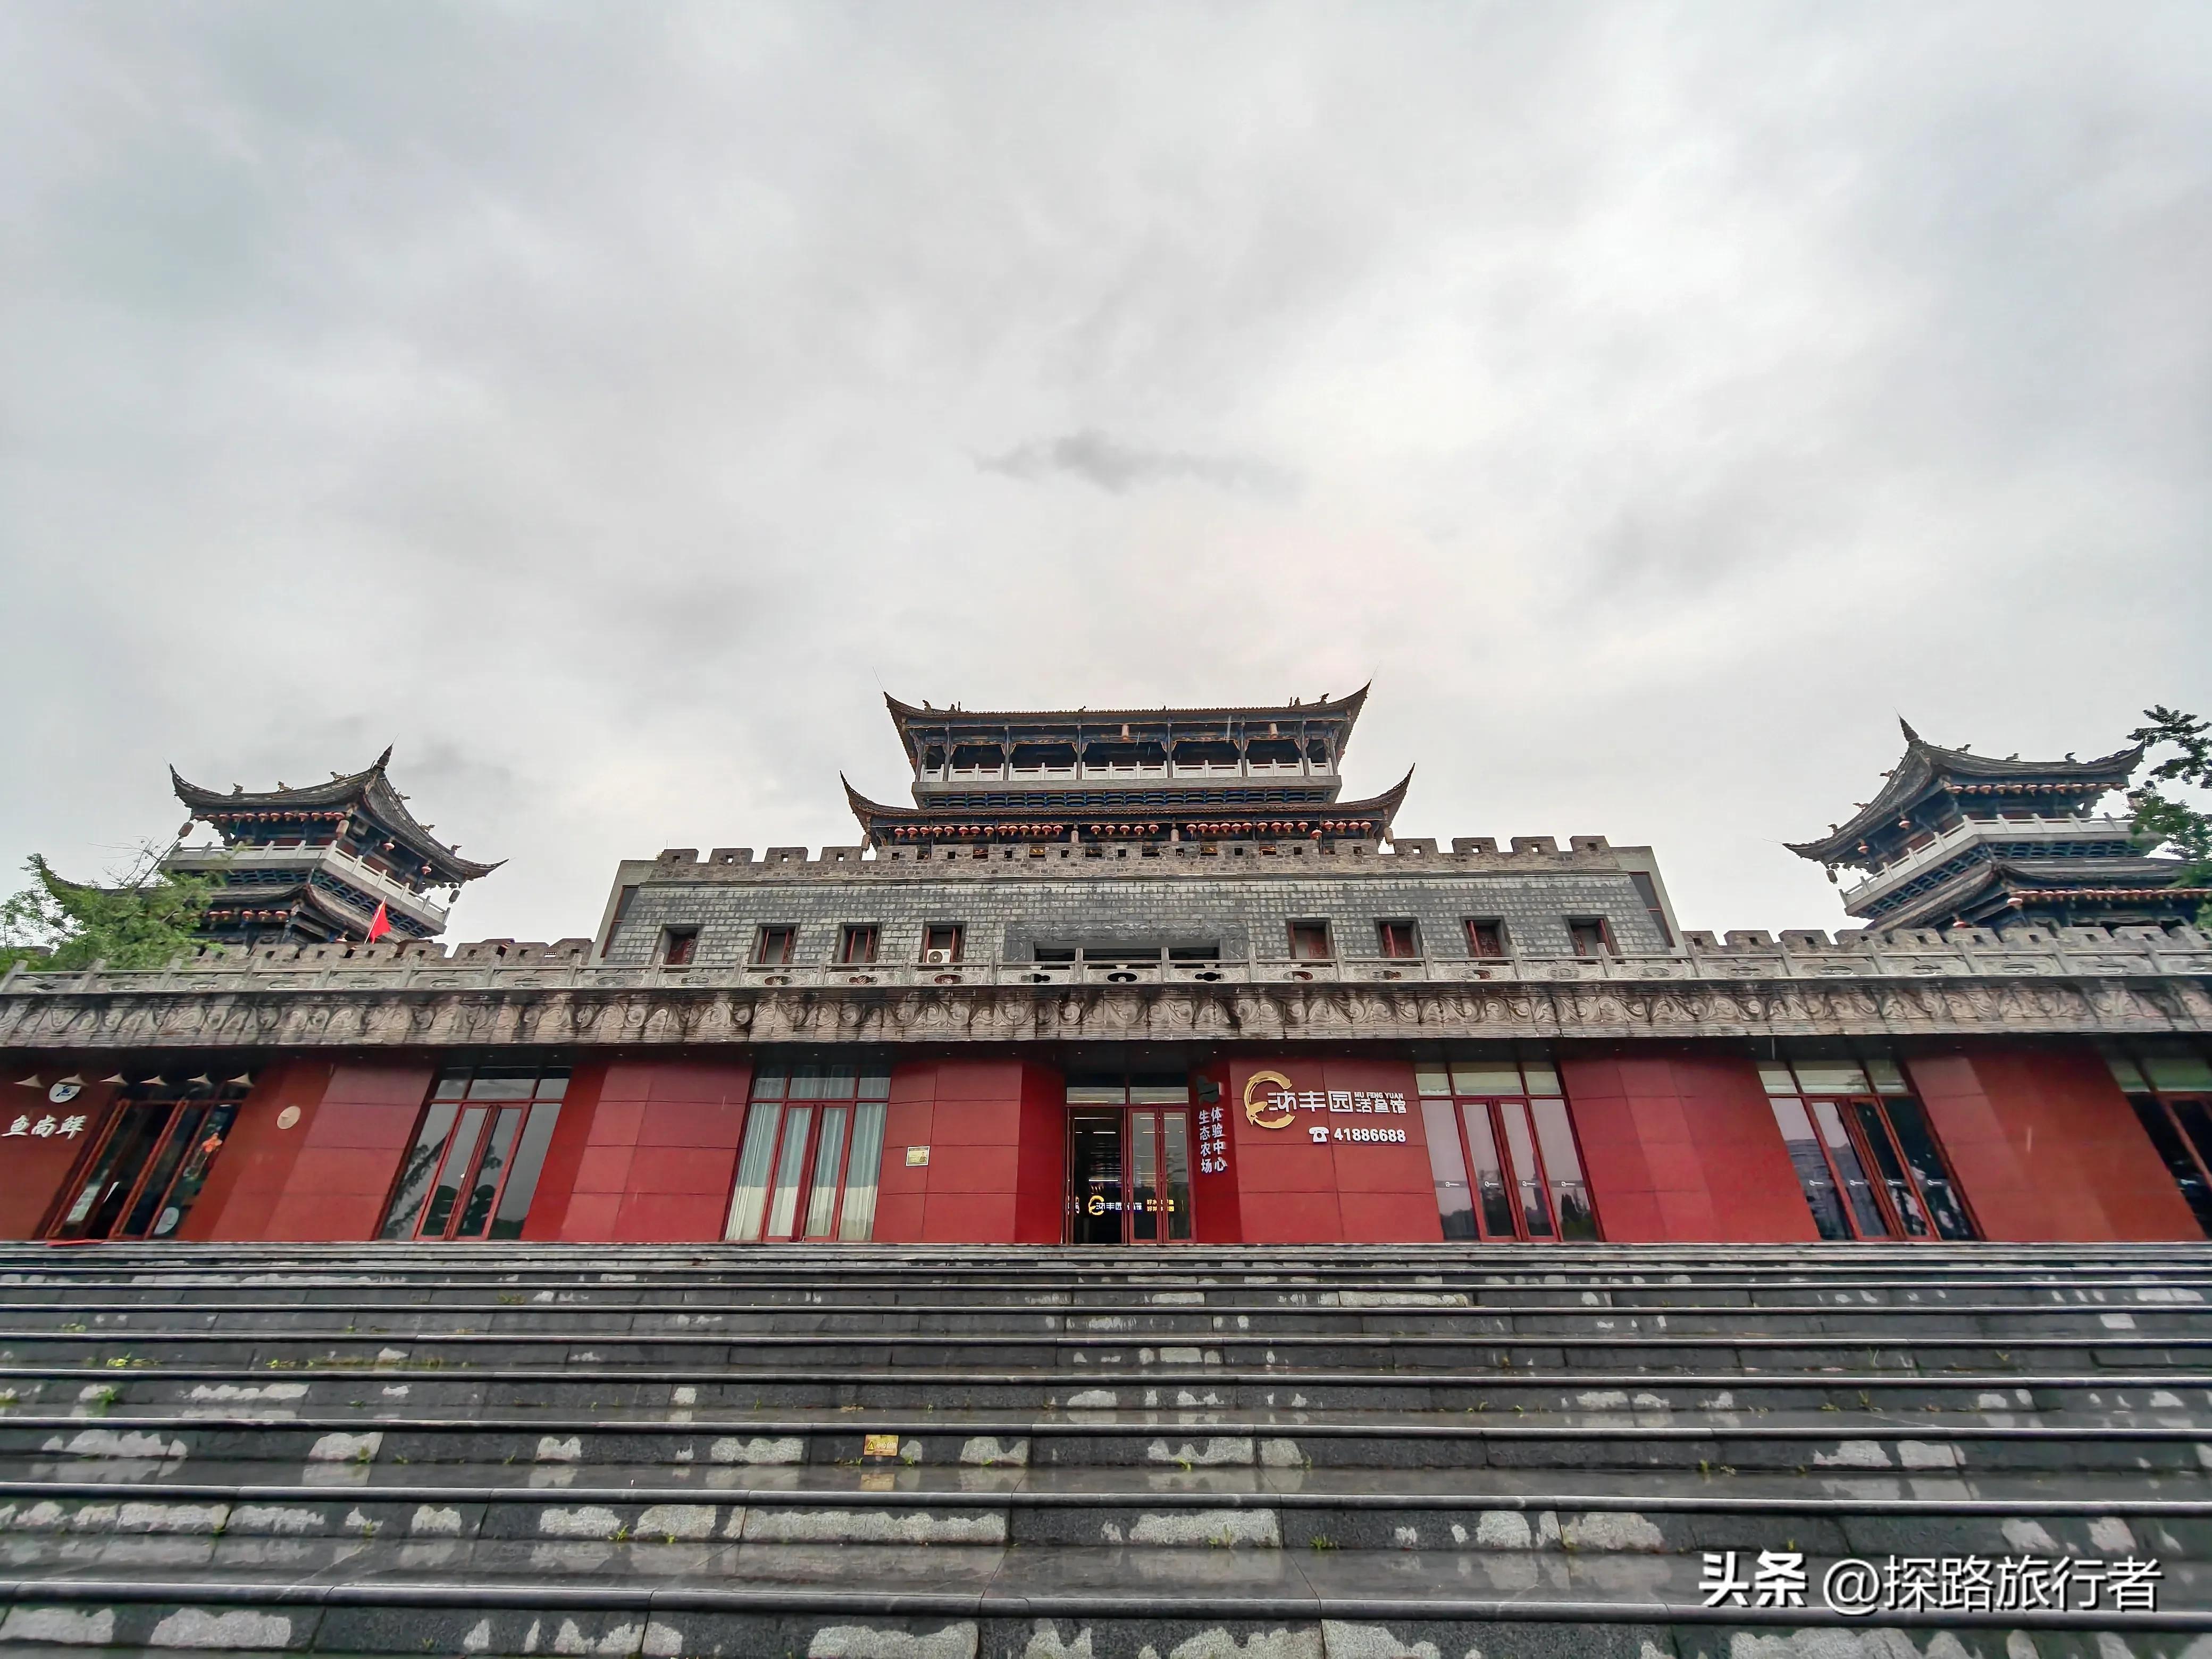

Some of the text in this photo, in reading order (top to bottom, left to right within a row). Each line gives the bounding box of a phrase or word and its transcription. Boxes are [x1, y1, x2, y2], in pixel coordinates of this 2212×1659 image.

[1, 1115, 87, 1139] 鱼尚鲜
[1199, 1109, 1212, 1174] 生态农场
[1211, 1106, 1228, 1172] 体验中心
[1334, 1128, 1406, 1142] 41886688
